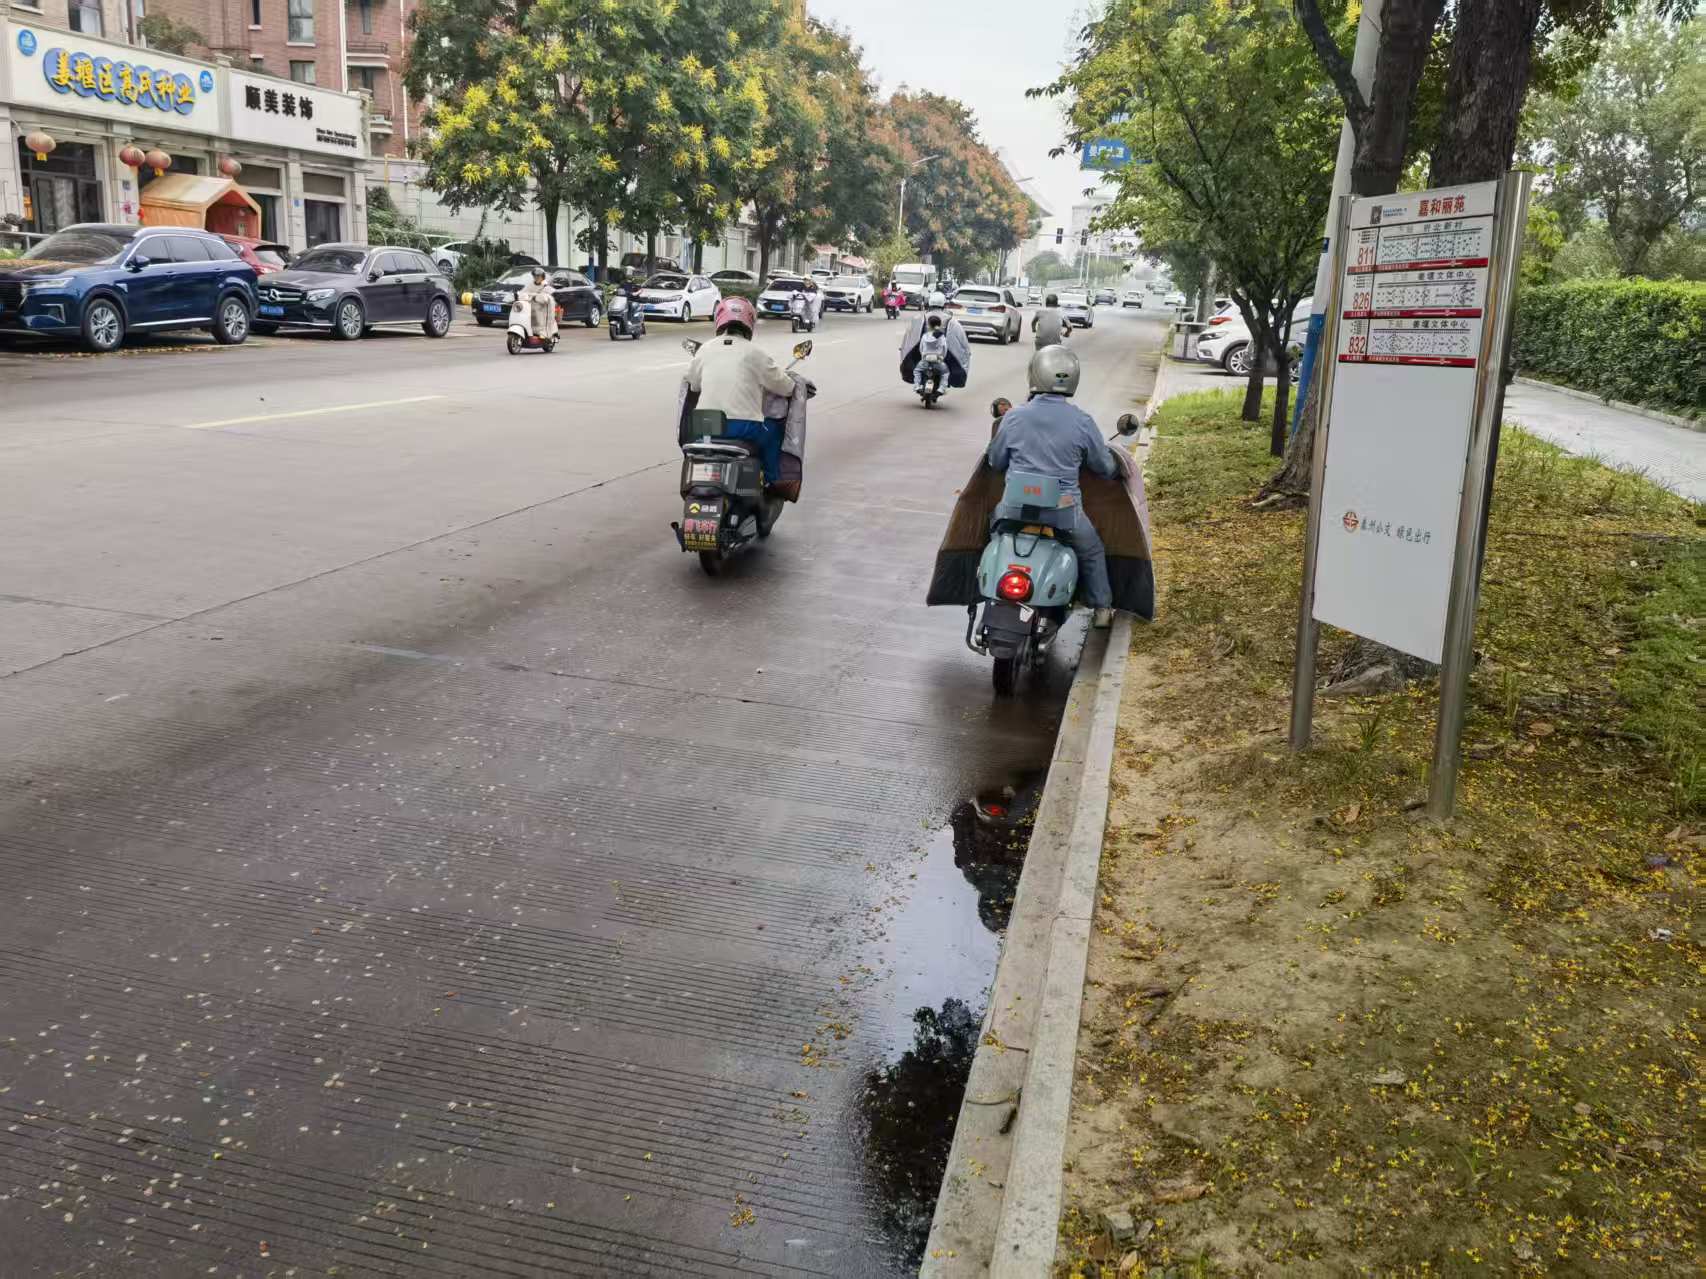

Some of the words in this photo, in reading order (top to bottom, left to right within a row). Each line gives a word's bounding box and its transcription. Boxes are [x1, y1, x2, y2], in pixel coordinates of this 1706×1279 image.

[52, 49, 196, 106] 姜堰区高氏种业
[245, 85, 313, 120] 顺美装饰
[1418, 194, 1466, 217] 嘉和丽苑
[1357, 246, 1374, 265] 811
[1352, 292, 1370, 310] 826
[1348, 336, 1366, 354] 832
